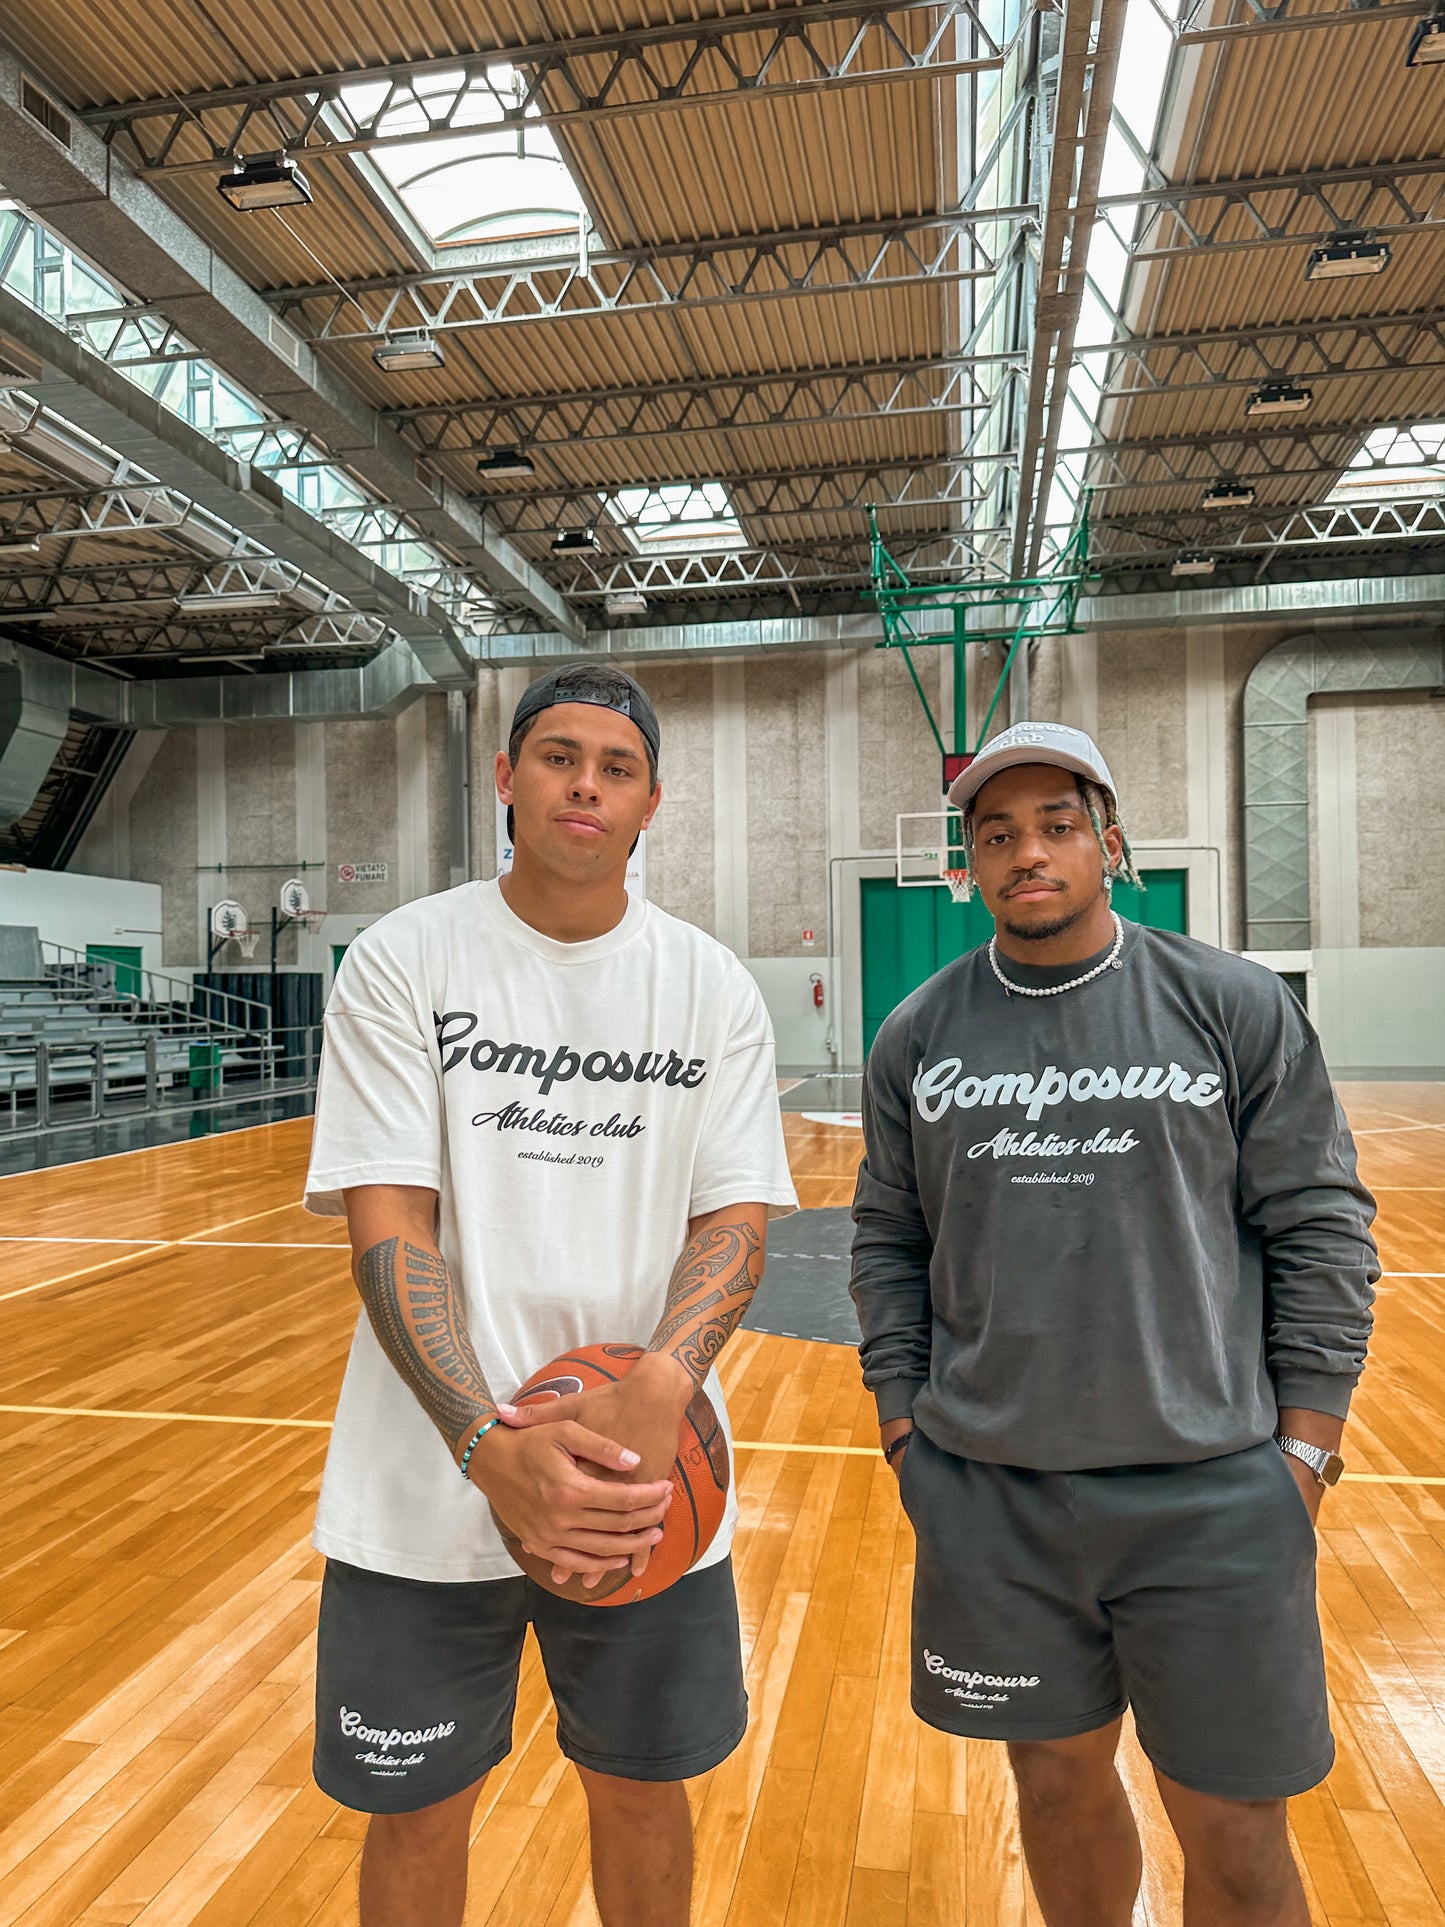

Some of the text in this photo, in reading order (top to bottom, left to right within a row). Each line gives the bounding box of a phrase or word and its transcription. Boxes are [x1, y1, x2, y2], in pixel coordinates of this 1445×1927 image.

[979, 724, 1078, 756] posure
[1000, 733, 1044, 748] club
[355, 864, 386, 872] VIETATO
[355, 873, 385, 881] FUMARE
[433, 1011, 708, 1096] Composure
[912, 1057, 1223, 1122] Composure
[472, 1101, 646, 1139] Athletics club
[517, 1150, 604, 1168] established 2019
[967, 1127, 1140, 1159] Athletics club
[1011, 1171, 1095, 1186] established 2019
[923, 1648, 1040, 1689] Composure
[340, 1705, 456, 1752] Composure
[355, 1751, 426, 1766] Athletics club
